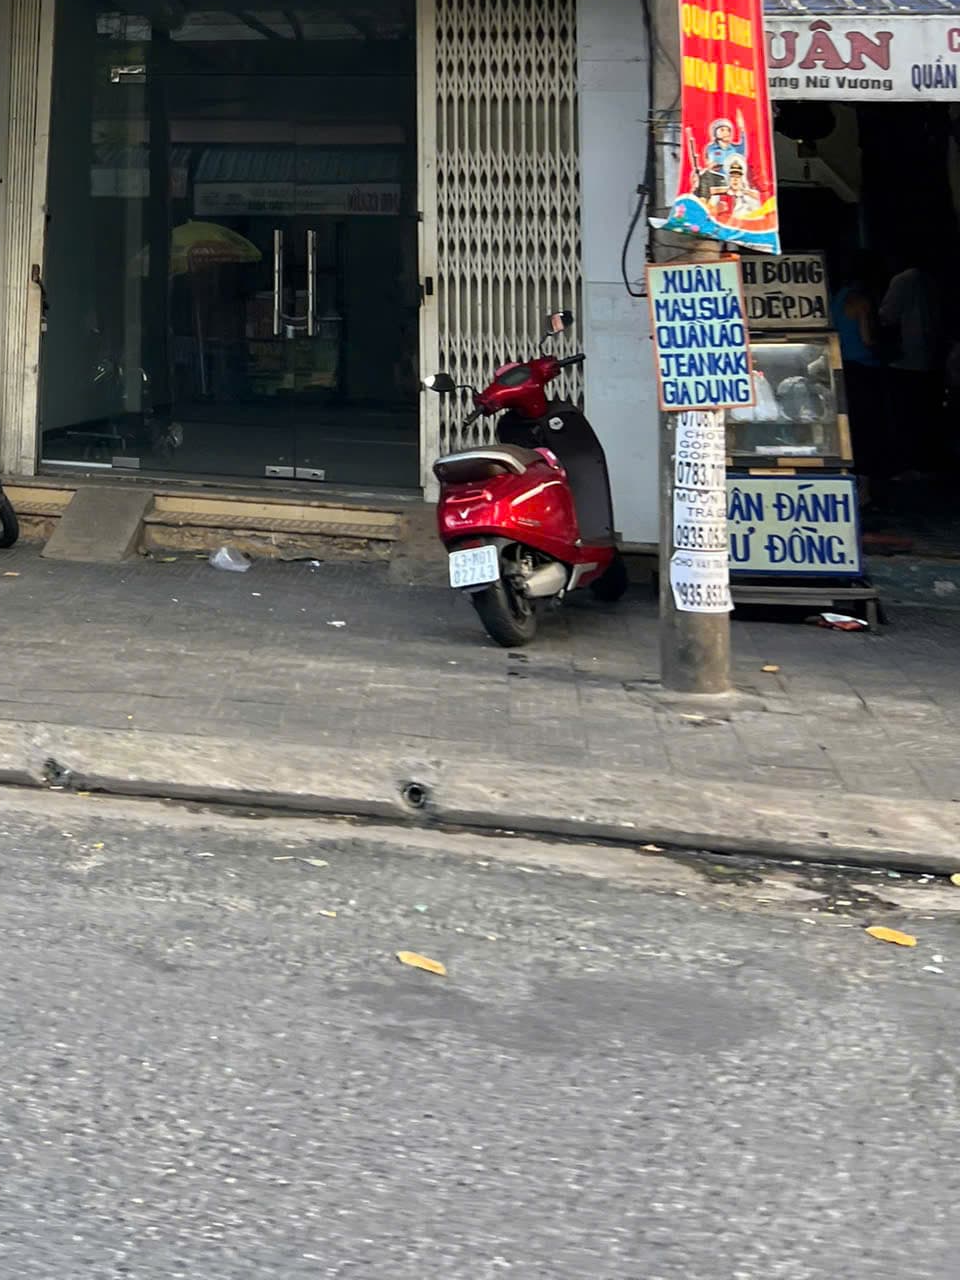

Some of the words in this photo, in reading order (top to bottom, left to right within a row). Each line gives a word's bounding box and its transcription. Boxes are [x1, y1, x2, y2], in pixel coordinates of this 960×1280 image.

[765, 19, 894, 70] UÂN
[806, 75, 829, 88] Nữ
[836, 75, 893, 91] Vương
[727, 487, 764, 524] ẬN
[772, 484, 851, 523] ĐÁNH
[728, 526, 756, 562] Ư
[764, 526, 854, 564] ĐỒNG.
